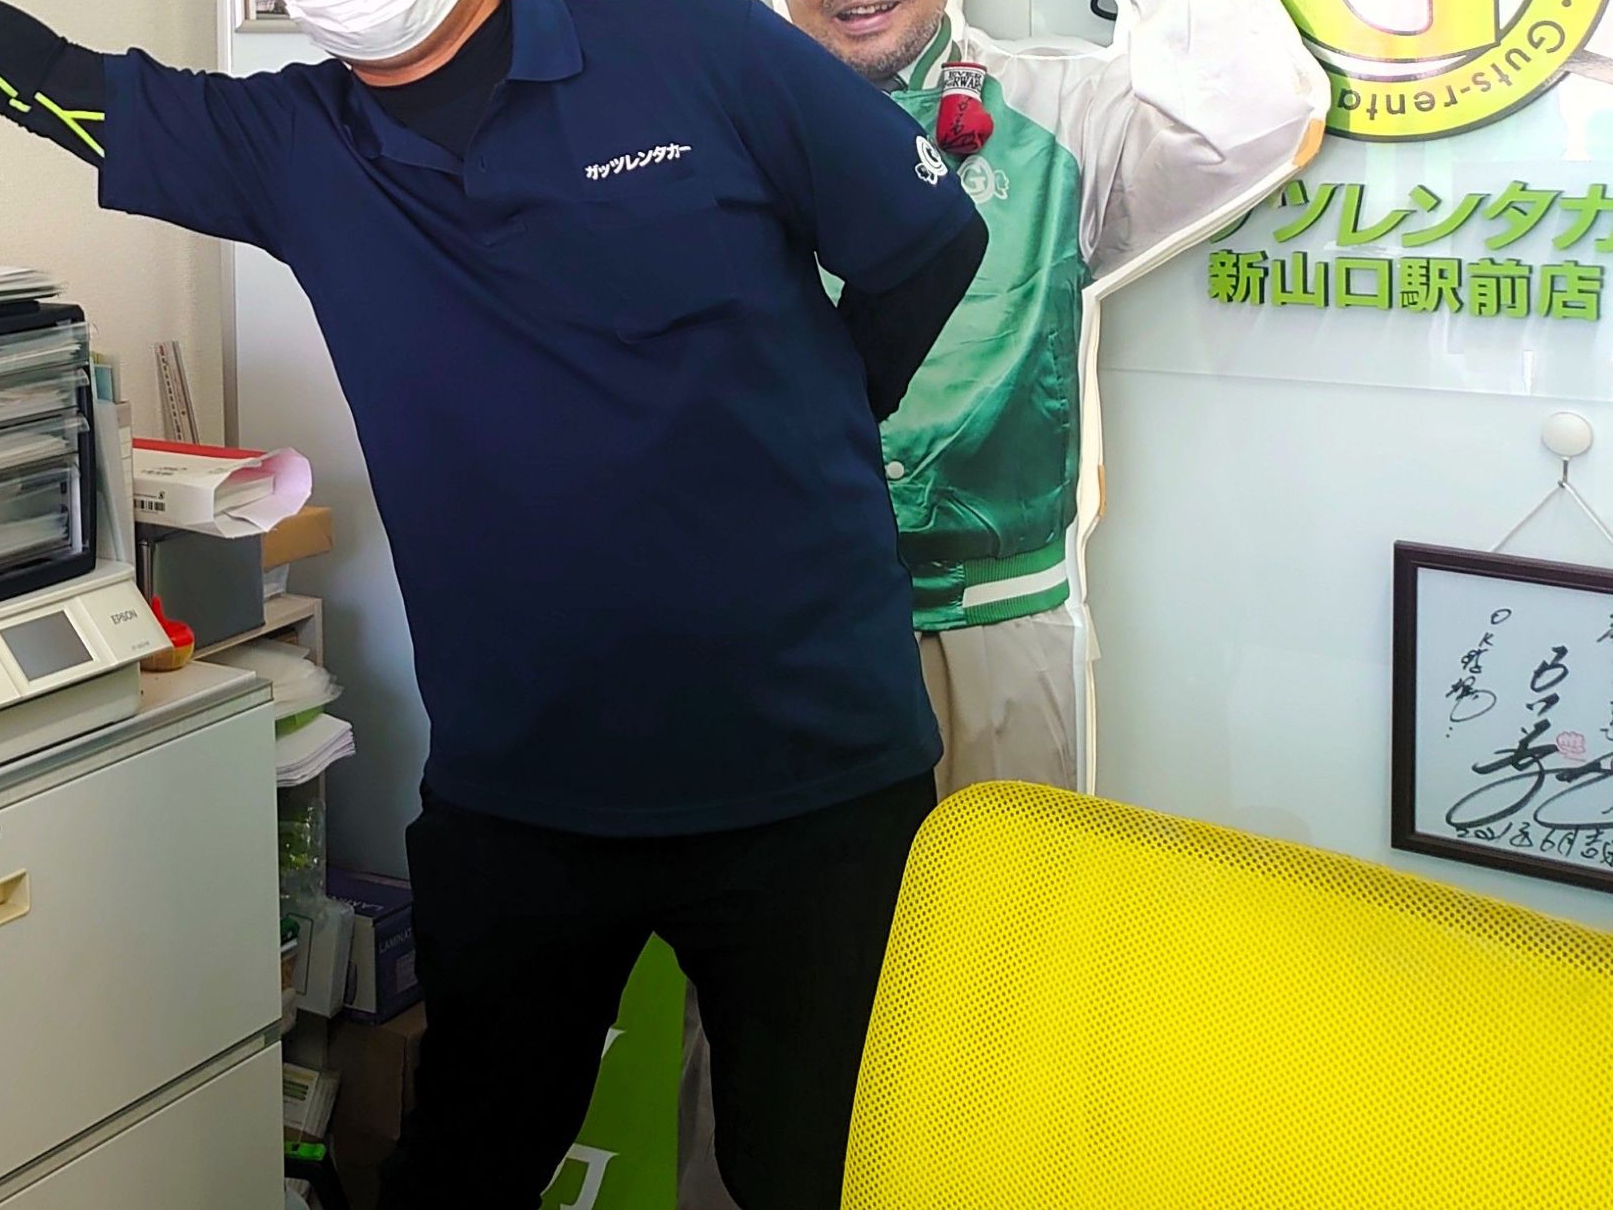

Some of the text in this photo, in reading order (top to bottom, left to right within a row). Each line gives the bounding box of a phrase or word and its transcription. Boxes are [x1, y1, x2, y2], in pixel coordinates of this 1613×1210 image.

[584, 142, 692, 181] ガッツレンタカー
[1209, 178, 1613, 254] ツレンタカ
[1207, 248, 1606, 322] 新山口駅前店
[110, 609, 138, 625] EPSON
